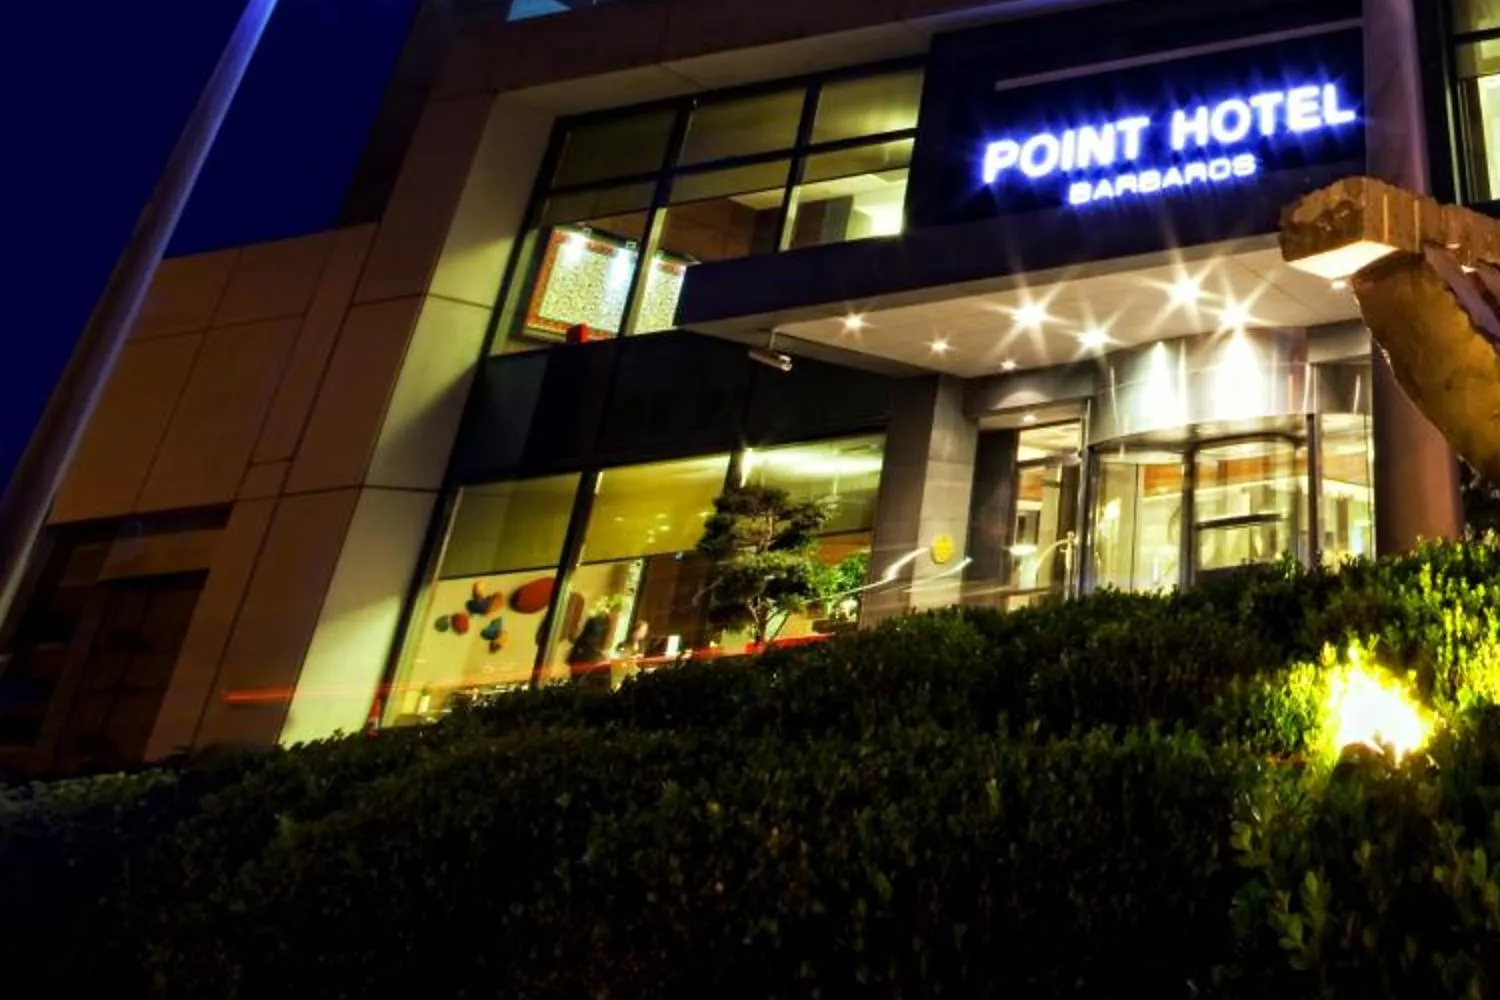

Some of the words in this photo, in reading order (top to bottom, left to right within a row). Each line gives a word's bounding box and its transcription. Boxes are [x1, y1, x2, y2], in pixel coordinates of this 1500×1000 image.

[981, 114, 1151, 185] POINT
[1169, 82, 1357, 152] HOTEL
[1067, 152, 1257, 207] BARBAROS
